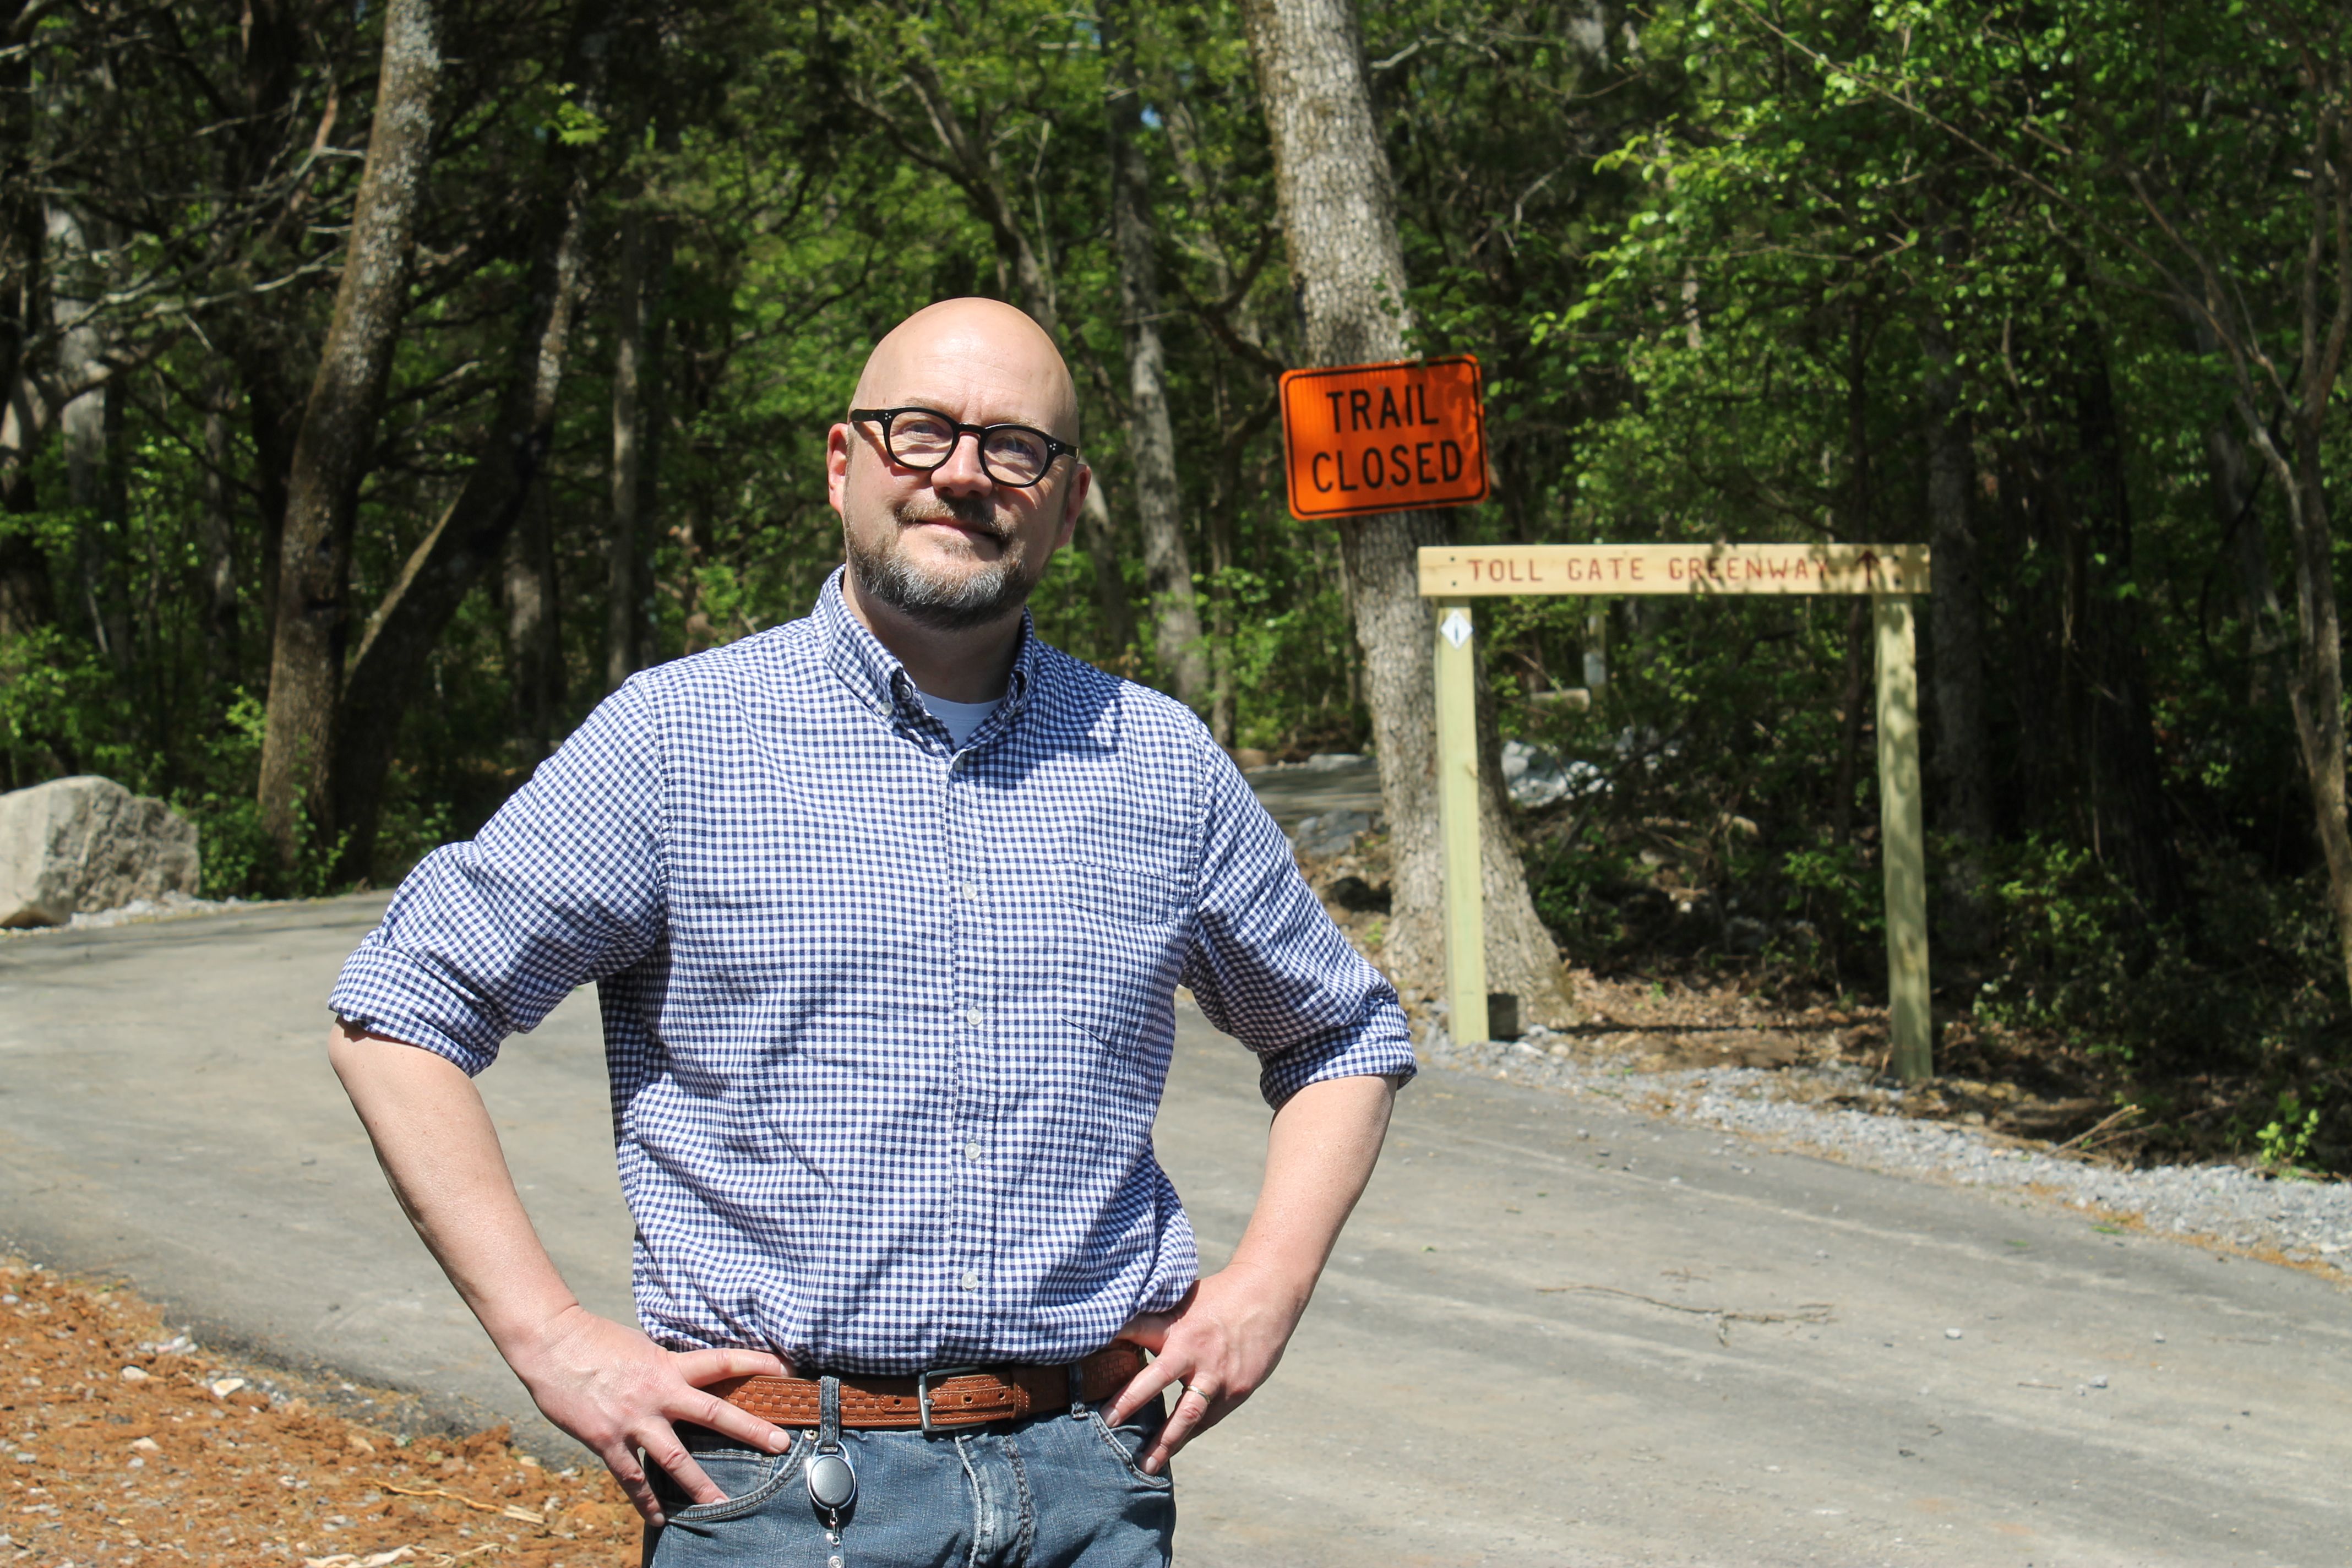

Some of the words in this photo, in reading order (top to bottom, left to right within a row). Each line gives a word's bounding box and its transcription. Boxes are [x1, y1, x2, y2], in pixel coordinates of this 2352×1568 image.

[1326, 384, 1440, 433] TRAIL
[1311, 439, 1463, 493] CLOSED
[1467, 558, 1543, 581] TOLL
[1567, 557, 1644, 581] GATE
[1669, 557, 1828, 580] GREENWAY
